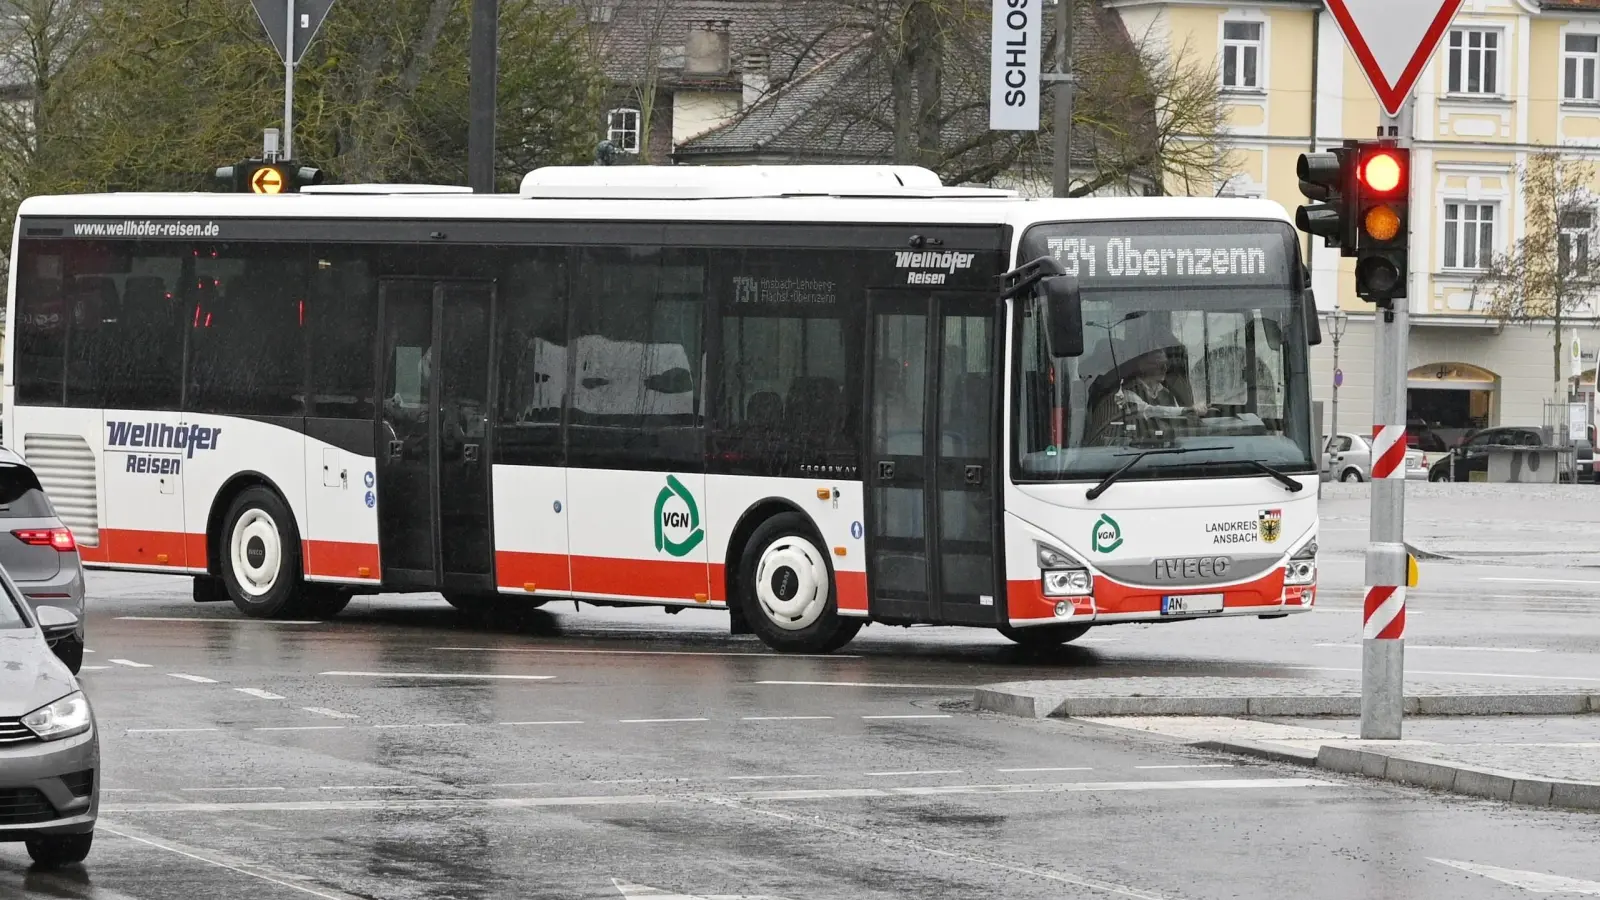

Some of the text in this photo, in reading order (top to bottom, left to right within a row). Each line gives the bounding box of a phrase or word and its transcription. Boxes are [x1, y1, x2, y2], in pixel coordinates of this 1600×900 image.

[74, 220, 220, 236] www.wellhöfer-reisen.de
[895, 250, 975, 274] Wellhöfer
[1047, 237, 1266, 276] 734 Obernzenn
[907, 271, 946, 284] Reisen
[732, 276, 759, 302] 734
[106, 421, 222, 459] Wellhöfer
[126, 454, 181, 475] Reisen
[800, 464, 857, 473] CROSSWAY
[663, 511, 690, 528] VGN
[1205, 520, 1258, 533] LANDKREIS
[1098, 531, 1115, 540] VGN
[1213, 532, 1258, 544] ANSBACH
[1155, 556, 1232, 579] IVECO
[780, 570, 790, 596] IVECO
[1168, 597, 1183, 610] AN
